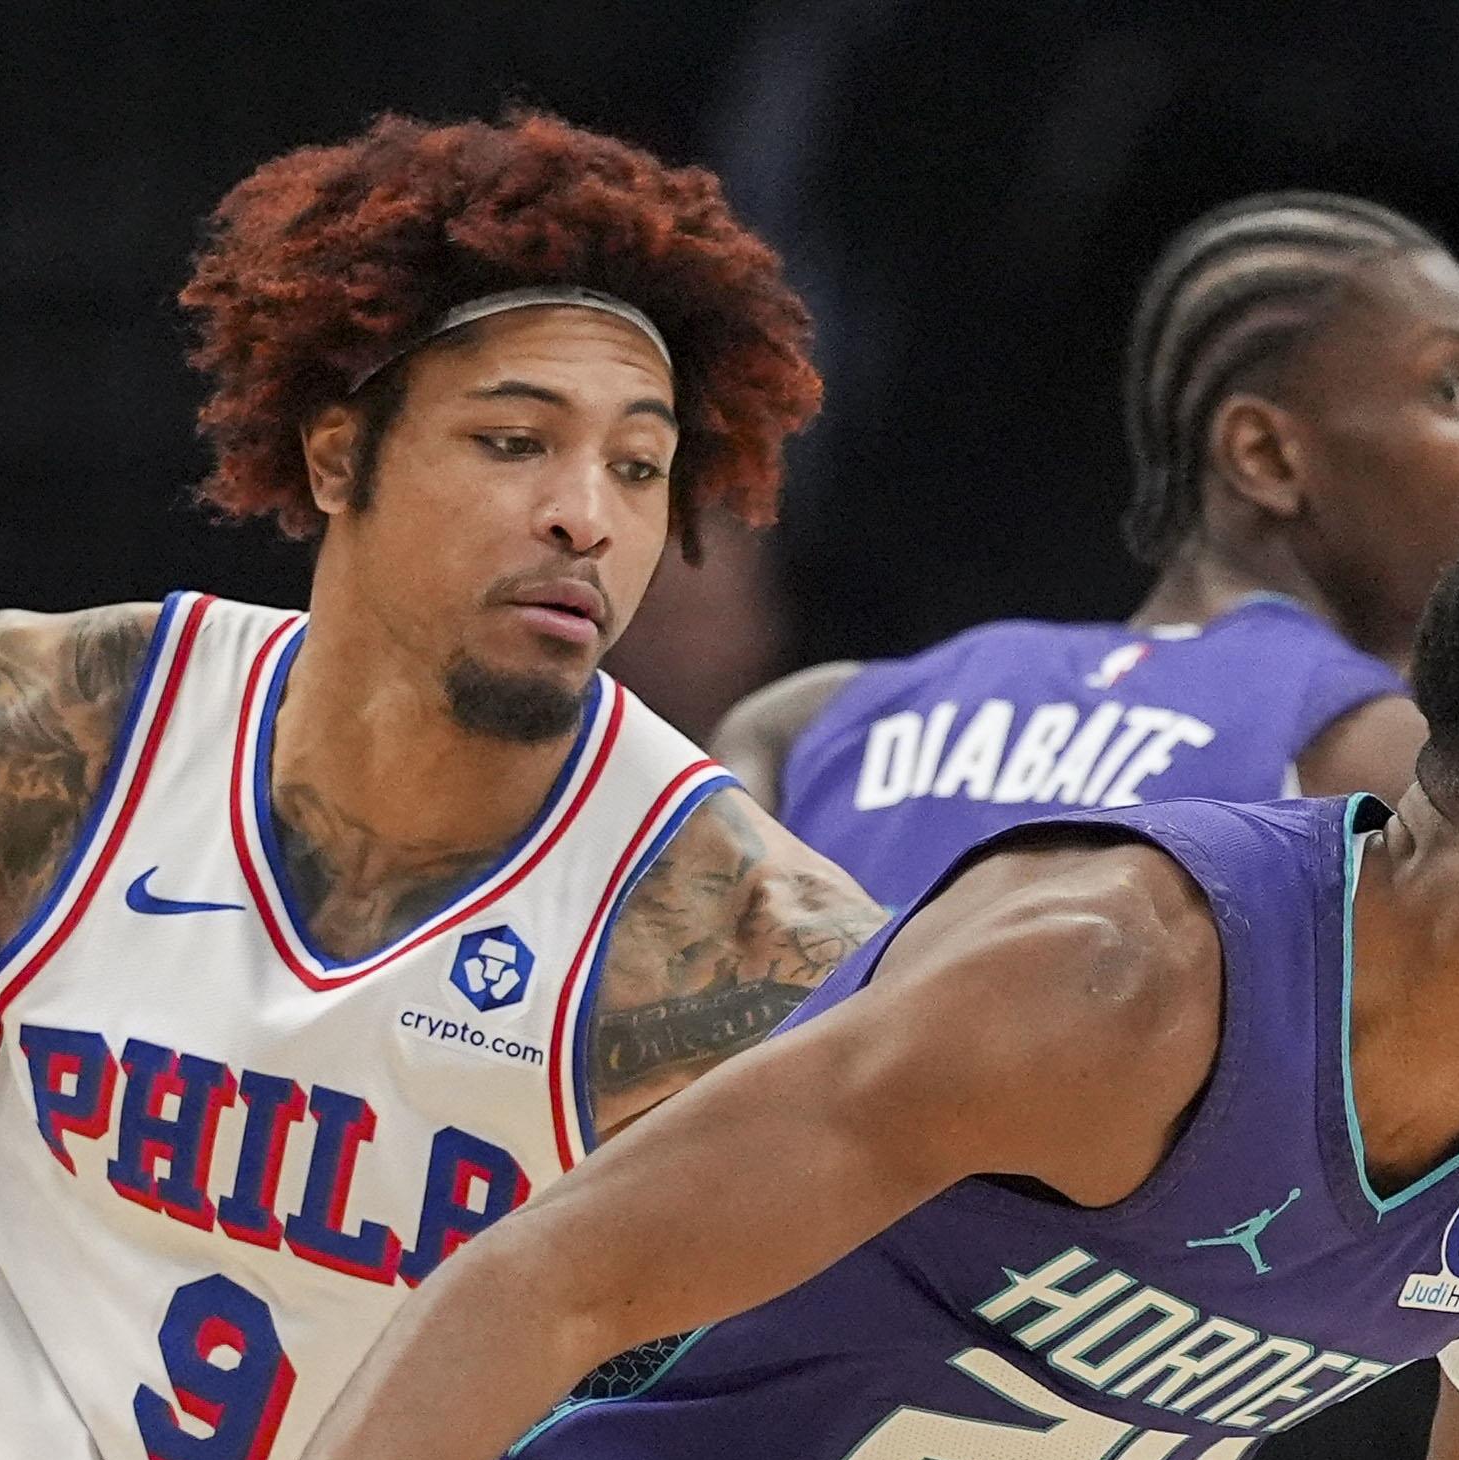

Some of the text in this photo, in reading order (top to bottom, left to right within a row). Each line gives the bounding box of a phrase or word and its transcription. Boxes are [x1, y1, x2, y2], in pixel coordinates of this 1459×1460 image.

[854, 698, 1216, 812] DIABATE
[400, 1011, 544, 1066] crypto.com
[19, 1023, 533, 1290] PHILA
[971, 1246, 1401, 1434] HORNET
[1404, 1279, 1450, 1305] Judi
